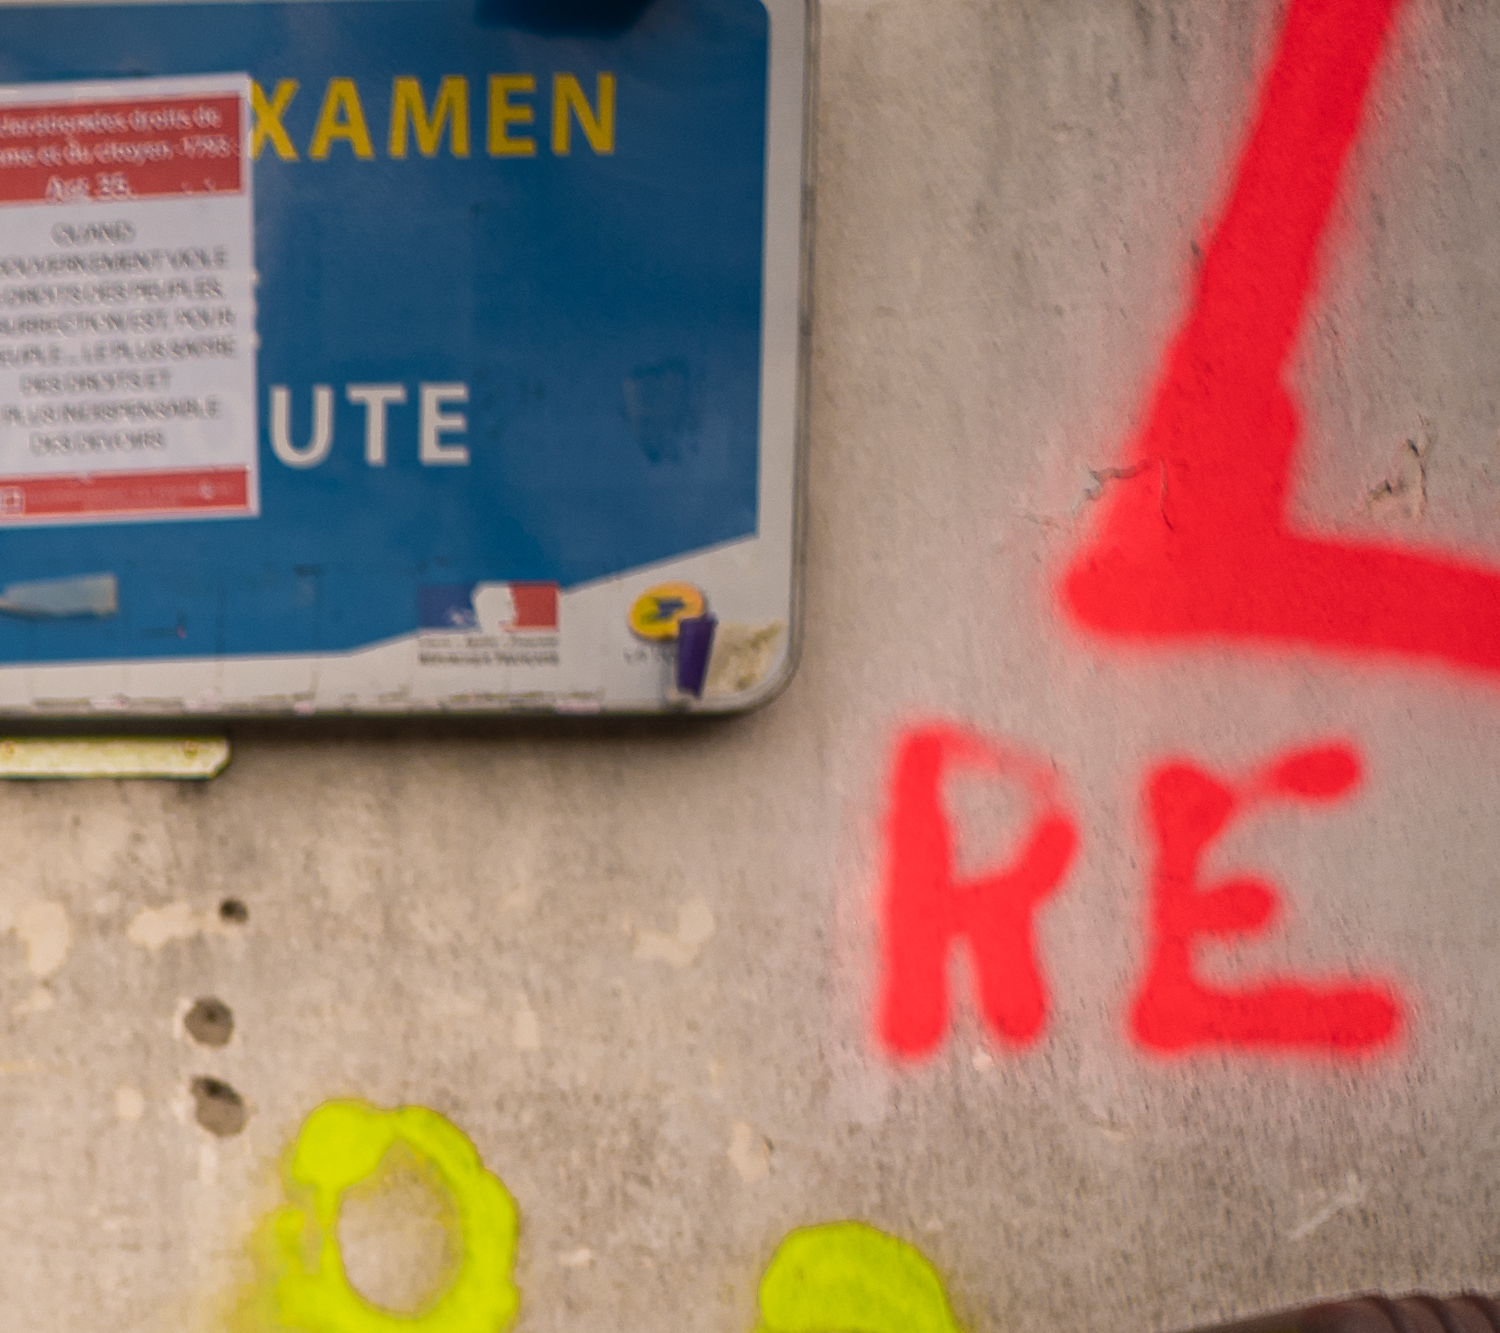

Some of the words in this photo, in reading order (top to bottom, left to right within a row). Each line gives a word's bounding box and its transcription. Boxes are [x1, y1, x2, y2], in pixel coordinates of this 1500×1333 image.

[250, 72, 617, 162] XAMEN
[51, 218, 135, 248] QUAND
[268, 380, 471, 469] UTE
[877, 725, 1406, 1061] RE
